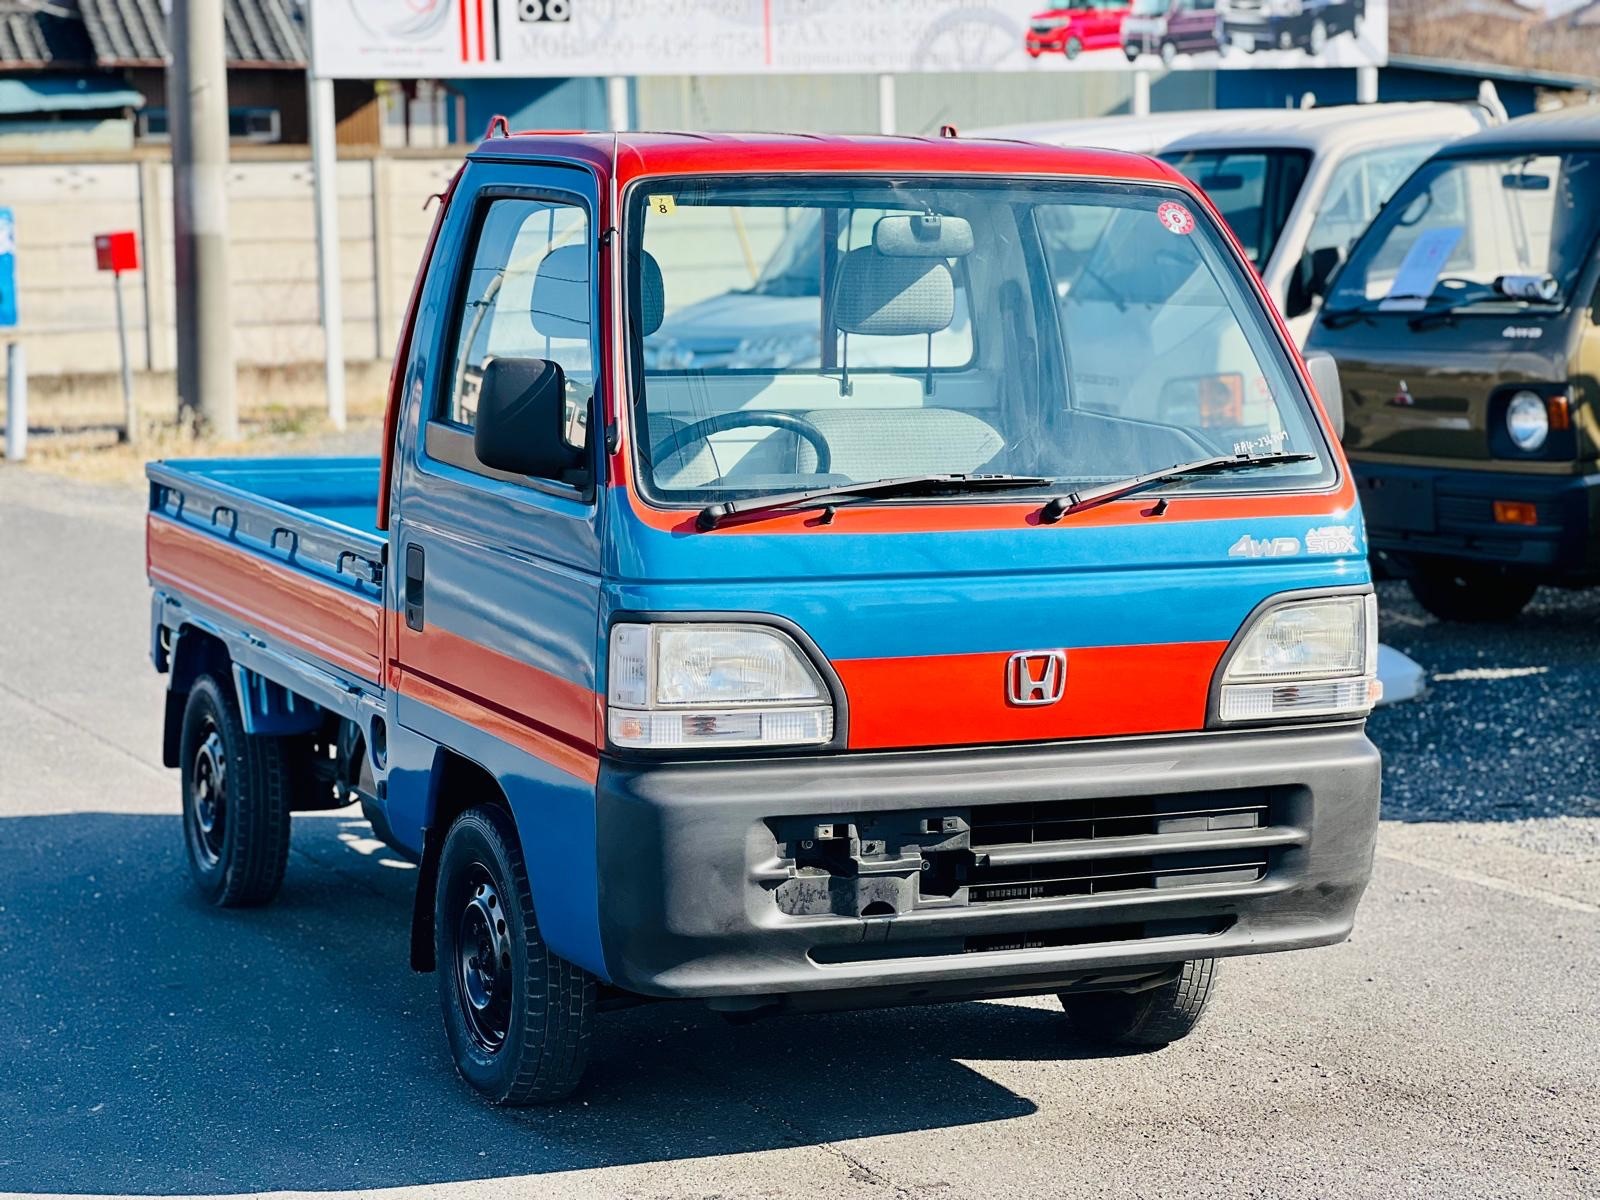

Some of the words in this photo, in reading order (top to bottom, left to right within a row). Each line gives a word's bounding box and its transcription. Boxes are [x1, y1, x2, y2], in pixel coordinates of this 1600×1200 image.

[659, 204, 667, 213] 8
[1171, 213, 1182, 224] 6
[1228, 534, 1301, 558] 4WD
[1305, 536, 1359, 554] SDX
